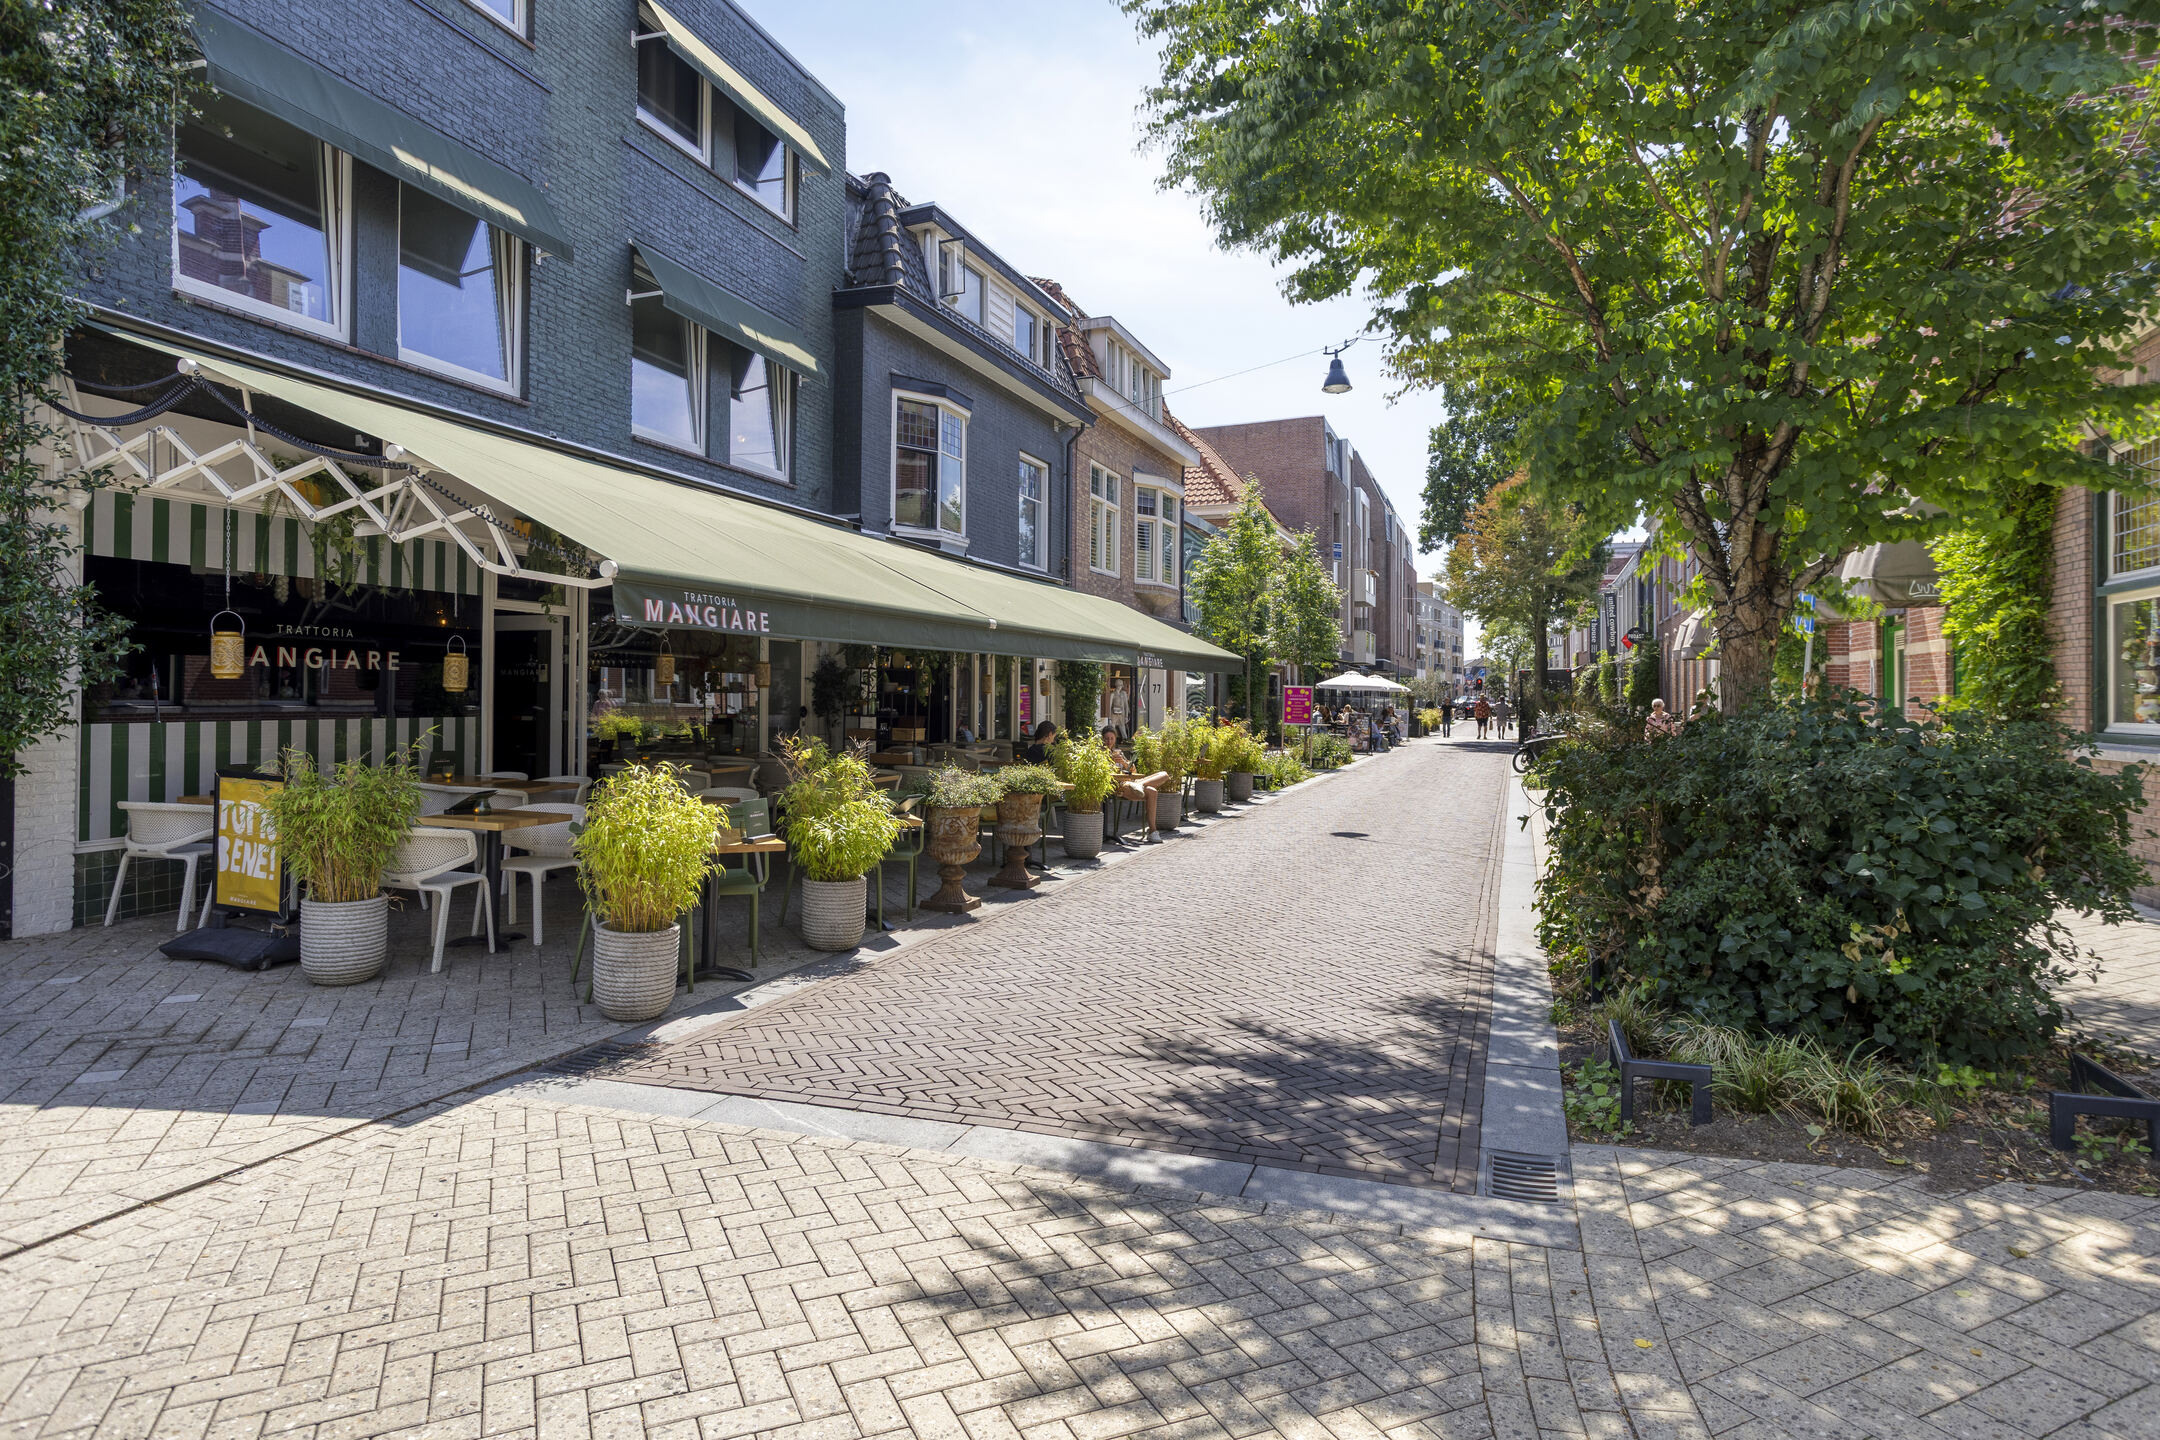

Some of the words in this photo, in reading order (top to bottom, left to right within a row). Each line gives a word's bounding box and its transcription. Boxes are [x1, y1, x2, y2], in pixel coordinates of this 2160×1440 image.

[683, 591, 737, 608] TRATTORIA
[1608, 596, 1616, 617] united
[644, 598, 770, 632] MANGIARE
[276, 624, 354, 638] TRATTORIA
[1608, 618, 1617, 647] cowboys
[250, 645, 400, 671] ANGIARE
[1152, 683, 1161, 694] 77
[217, 835, 276, 880] BENE!
